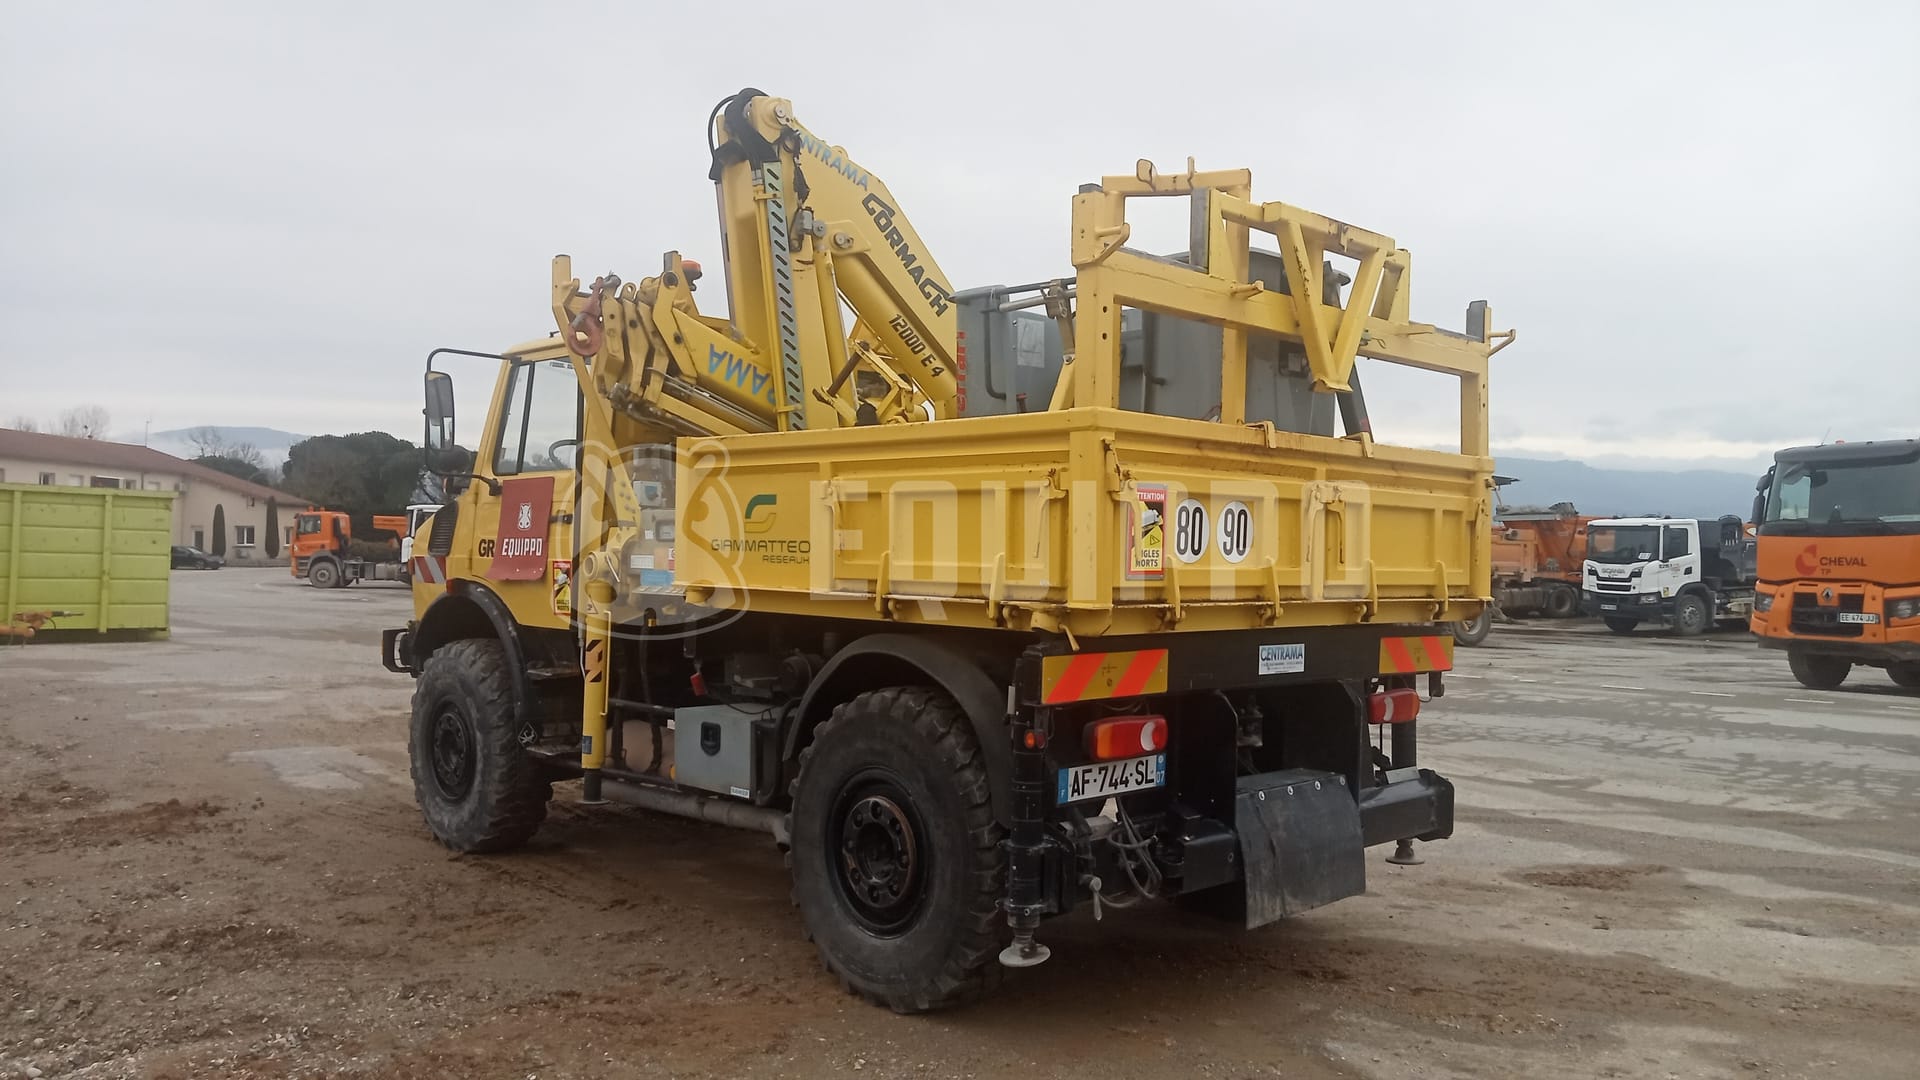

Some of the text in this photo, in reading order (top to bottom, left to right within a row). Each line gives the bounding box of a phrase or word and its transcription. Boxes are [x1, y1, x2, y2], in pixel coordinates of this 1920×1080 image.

[799, 131, 869, 191] NTRAMA
[889, 314, 926, 354] 12000
[1136, 491, 1165, 500] TTENTION
[1176, 505, 1203, 556] 80
[1222, 508, 1248, 556] 90
[501, 537, 543, 558] EQUIPPO
[711, 539, 811, 554] GIAMMATTEO
[1819, 556, 1867, 567] CHEVAL
[1260, 646, 1304, 661] CENTRAMA
